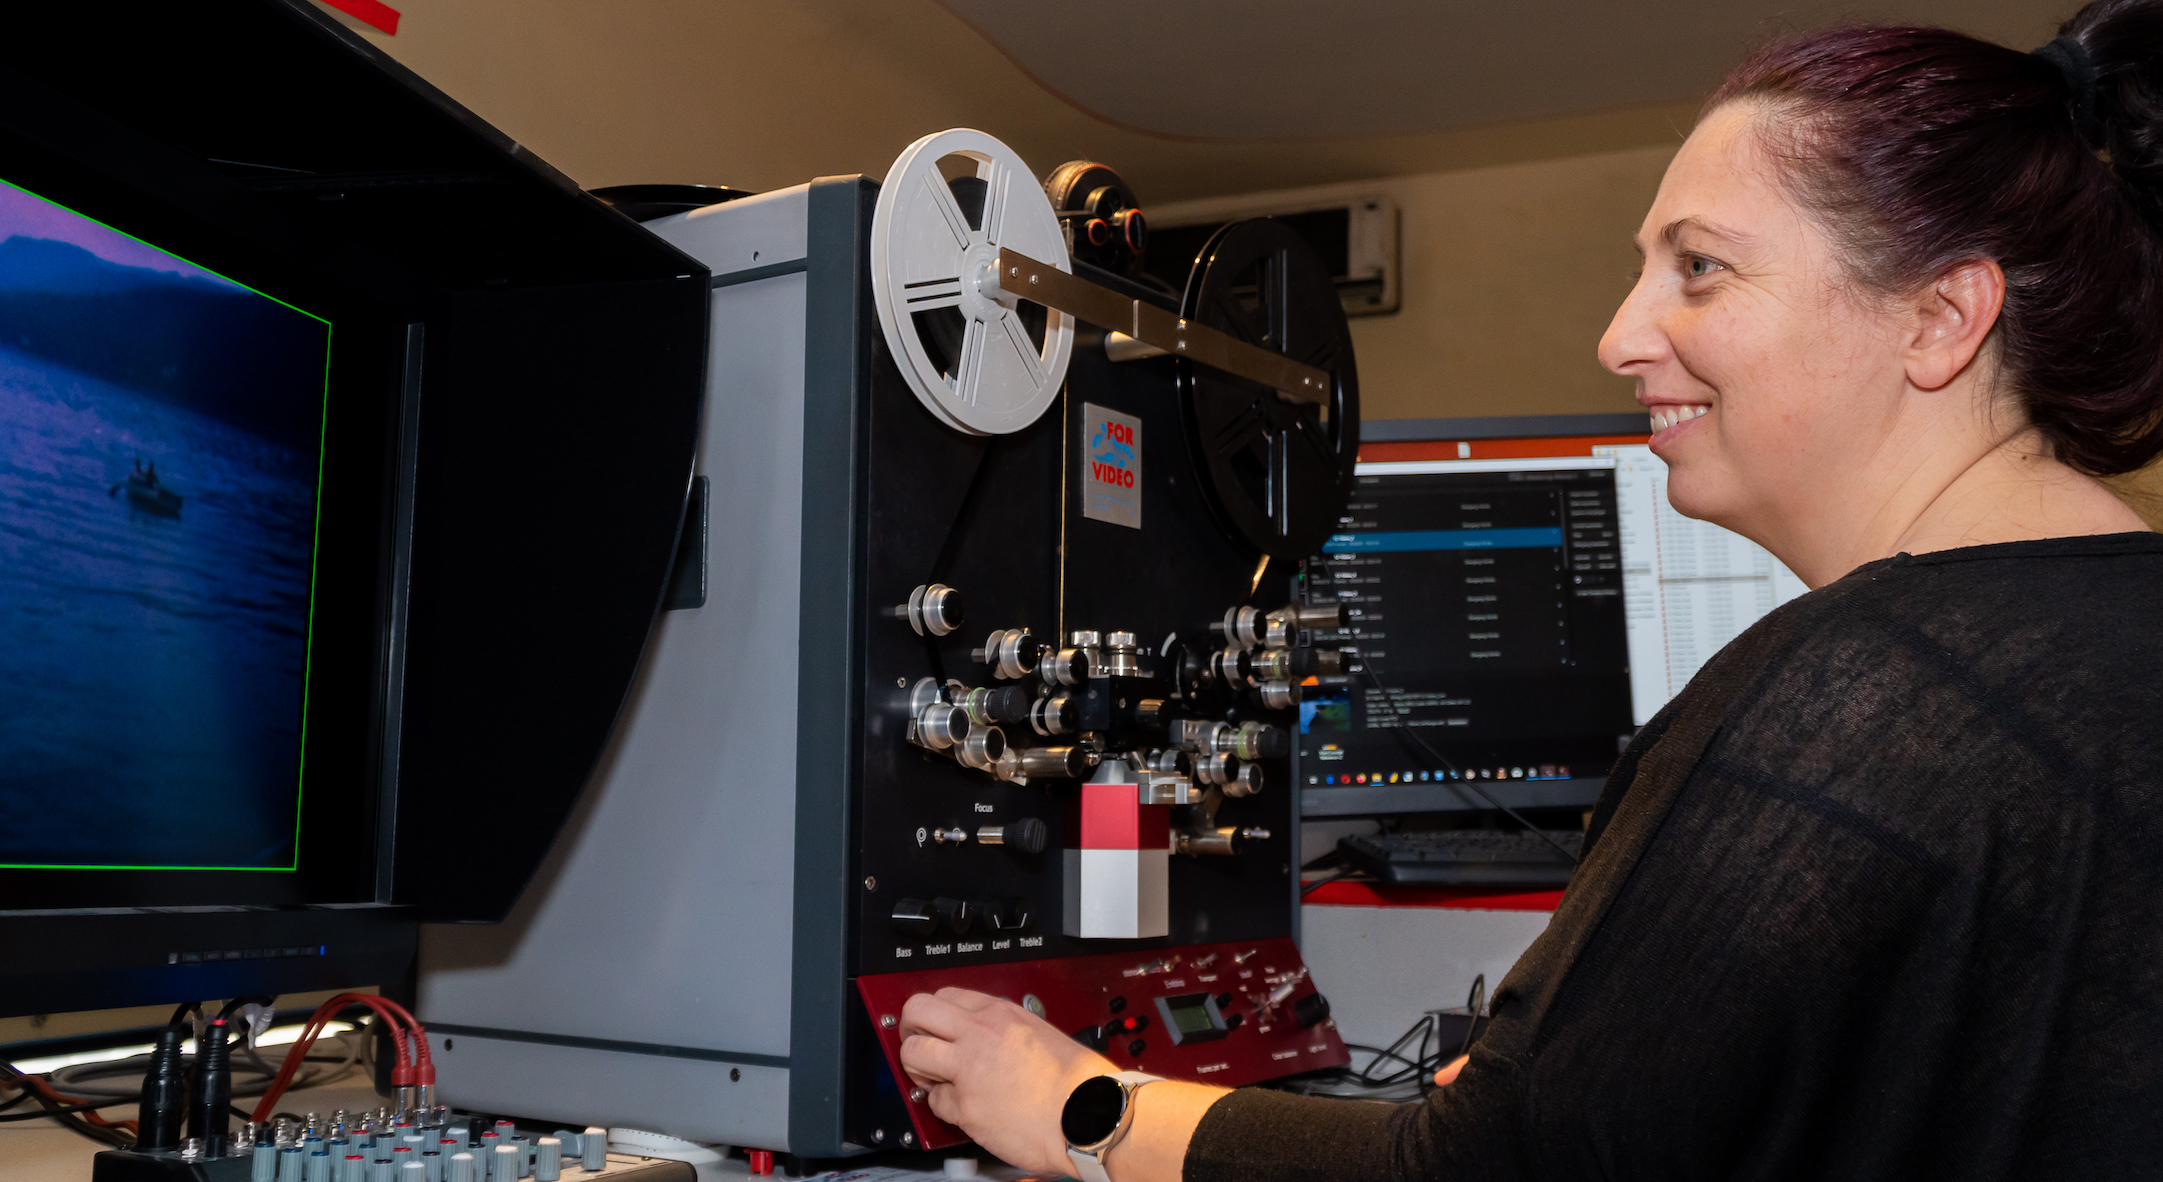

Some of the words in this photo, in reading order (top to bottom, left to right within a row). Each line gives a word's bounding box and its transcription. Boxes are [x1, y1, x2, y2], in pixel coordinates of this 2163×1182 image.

[1107, 421, 1134, 446] FOR
[1092, 461, 1134, 489] VIDEO
[974, 802, 994, 813] Focus
[957, 942, 983, 953] Balance
[992, 939, 1010, 950] Level
[1019, 936, 1043, 948] Treble2
[895, 947, 912, 959] Bass
[925, 944, 951, 956] Treble1
